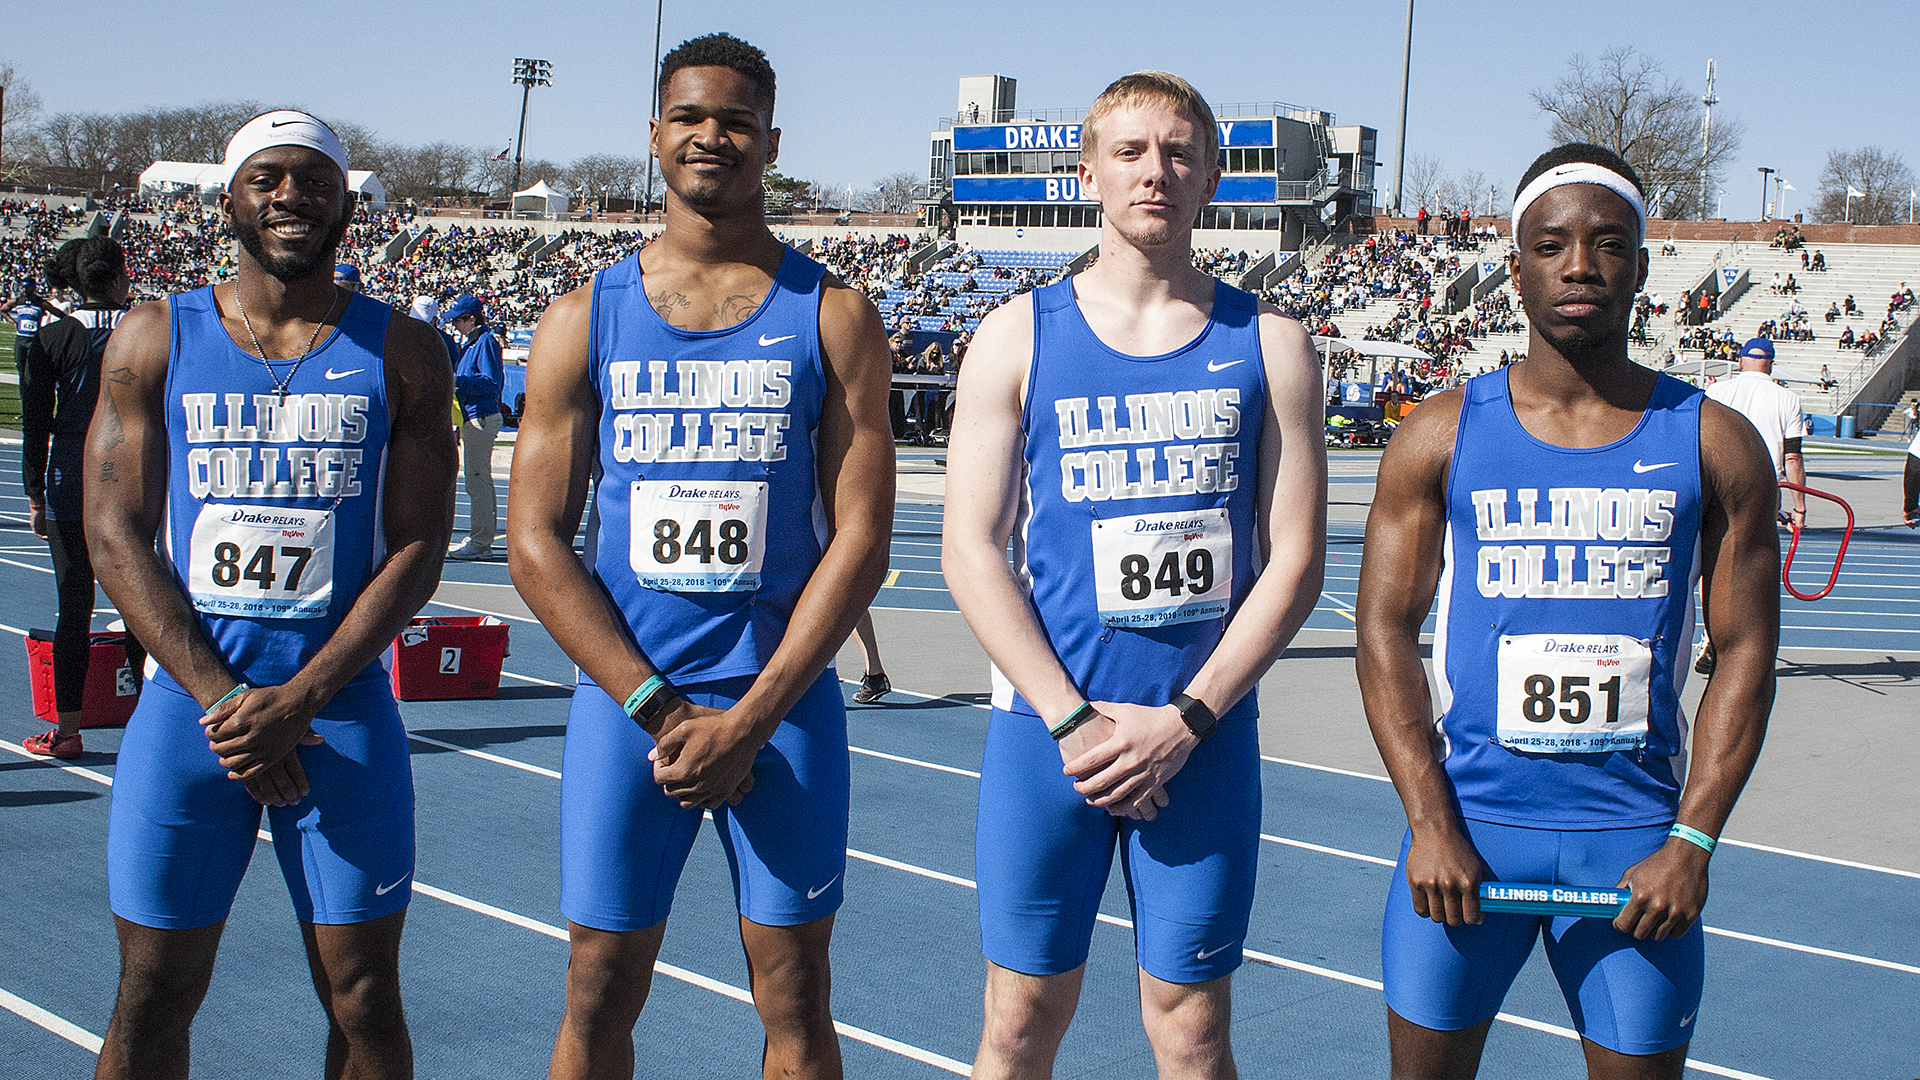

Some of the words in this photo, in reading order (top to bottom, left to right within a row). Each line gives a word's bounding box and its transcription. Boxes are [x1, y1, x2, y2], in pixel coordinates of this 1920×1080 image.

[1005, 125, 1079, 149] DRAKE
[609, 360, 792, 410] ILLINOIS
[182, 393, 369, 443] ILLINOIS
[614, 413, 791, 463] COLLEGE
[1054, 388, 1241, 449] ILLINOIS
[187, 448, 363, 498] COLLEGE
[668, 484, 707, 498] Drake
[708, 490, 741, 499] RELAYS
[1060, 443, 1240, 503] COLLEGE
[231, 508, 272, 524] Drake
[271, 516, 306, 526] RELAYS
[1133, 518, 1173, 533] Drake
[1174, 519, 1204, 530] RELAYS
[1470, 488, 1677, 541] ILLINOIS
[652, 518, 749, 565] 848
[211, 541, 315, 592] 847
[660, 578, 684, 587] 25-28,
[685, 578, 705, 586] 2018
[1120, 548, 1214, 601] 849
[1476, 545, 1672, 599] COLLEGE
[217, 600, 242, 611] 25-28,
[243, 603, 264, 612] 2018
[1131, 613, 1157, 623] 25-28,
[1158, 612, 1177, 621] 2018
[442, 649, 457, 672] 2
[1543, 638, 1585, 653] Drake
[1585, 644, 1620, 654] RELAYS
[1522, 674, 1622, 724] 851
[1531, 737, 1558, 748] 25-28,
[1560, 737, 1581, 747] 2018
[1552, 889, 1618, 905] COLLEGE
